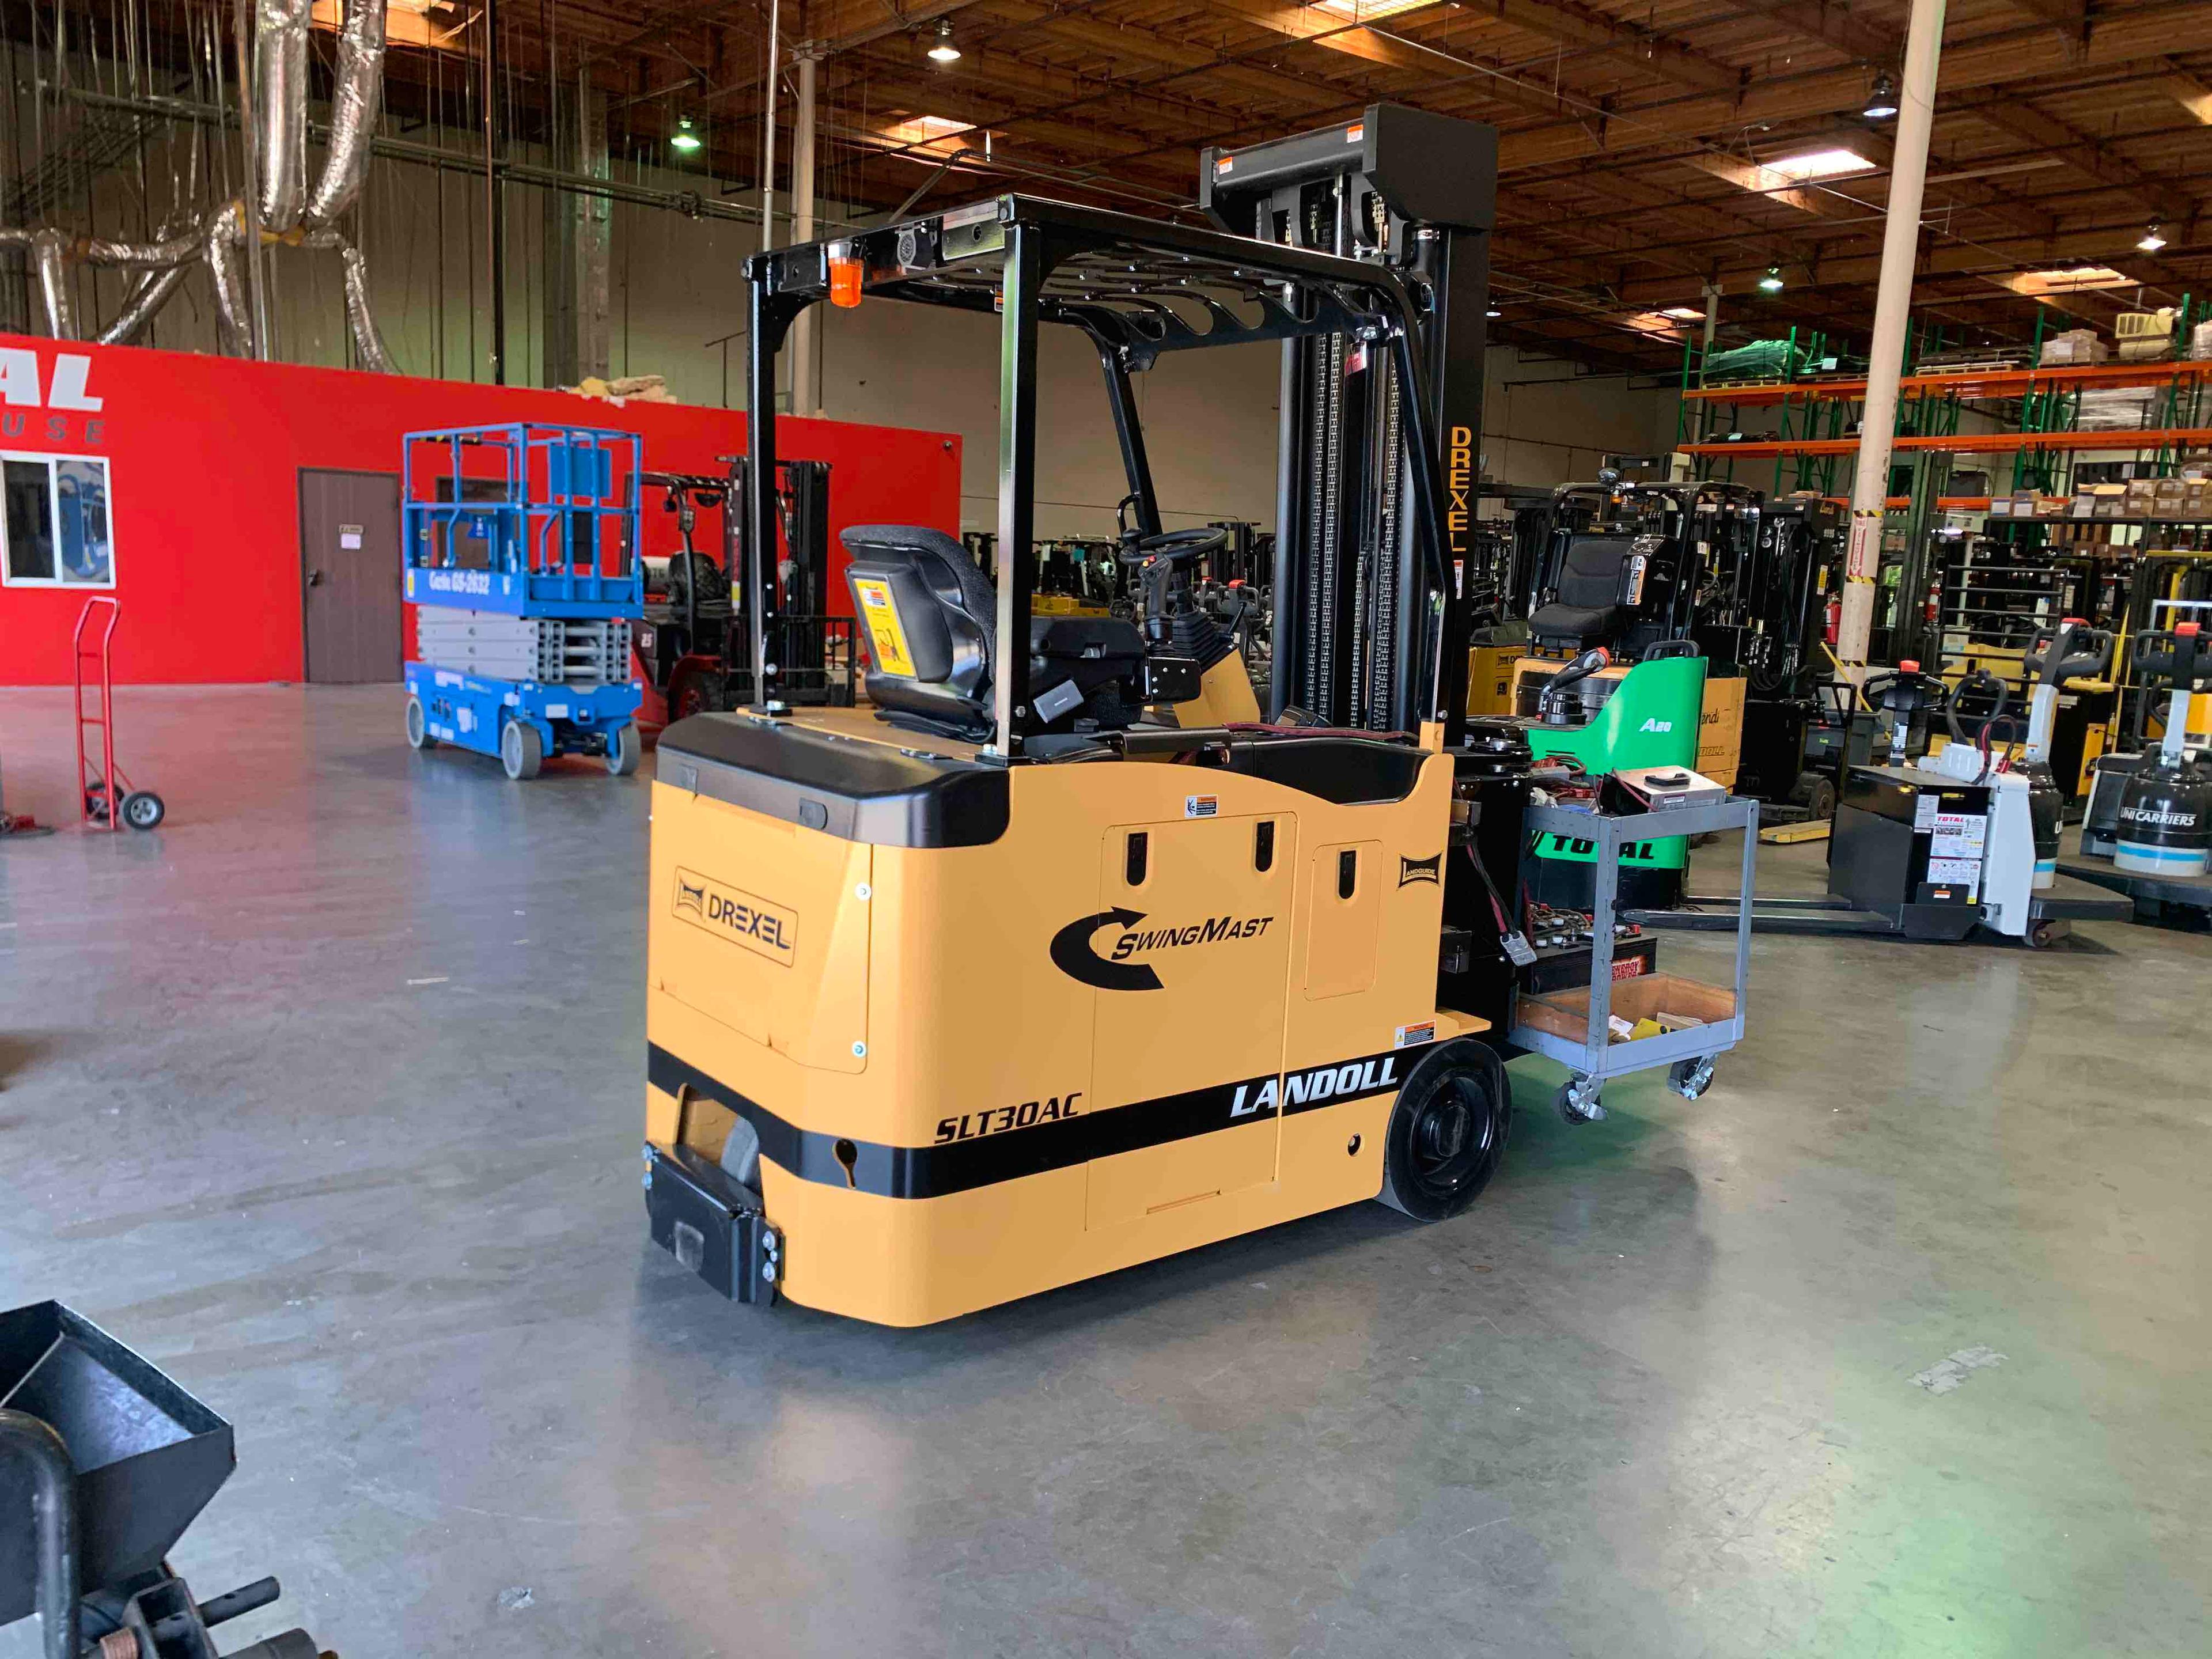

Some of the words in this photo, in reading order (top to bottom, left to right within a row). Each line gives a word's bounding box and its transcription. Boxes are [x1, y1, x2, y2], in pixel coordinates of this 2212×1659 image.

[1448, 426, 1472, 552] DREXEL
[1552, 835, 1655, 860] TOAL
[708, 892, 791, 950] DREXEL
[1229, 1056, 1399, 1118] LANDOLL
[934, 1092, 1083, 1145] SLT30AC
